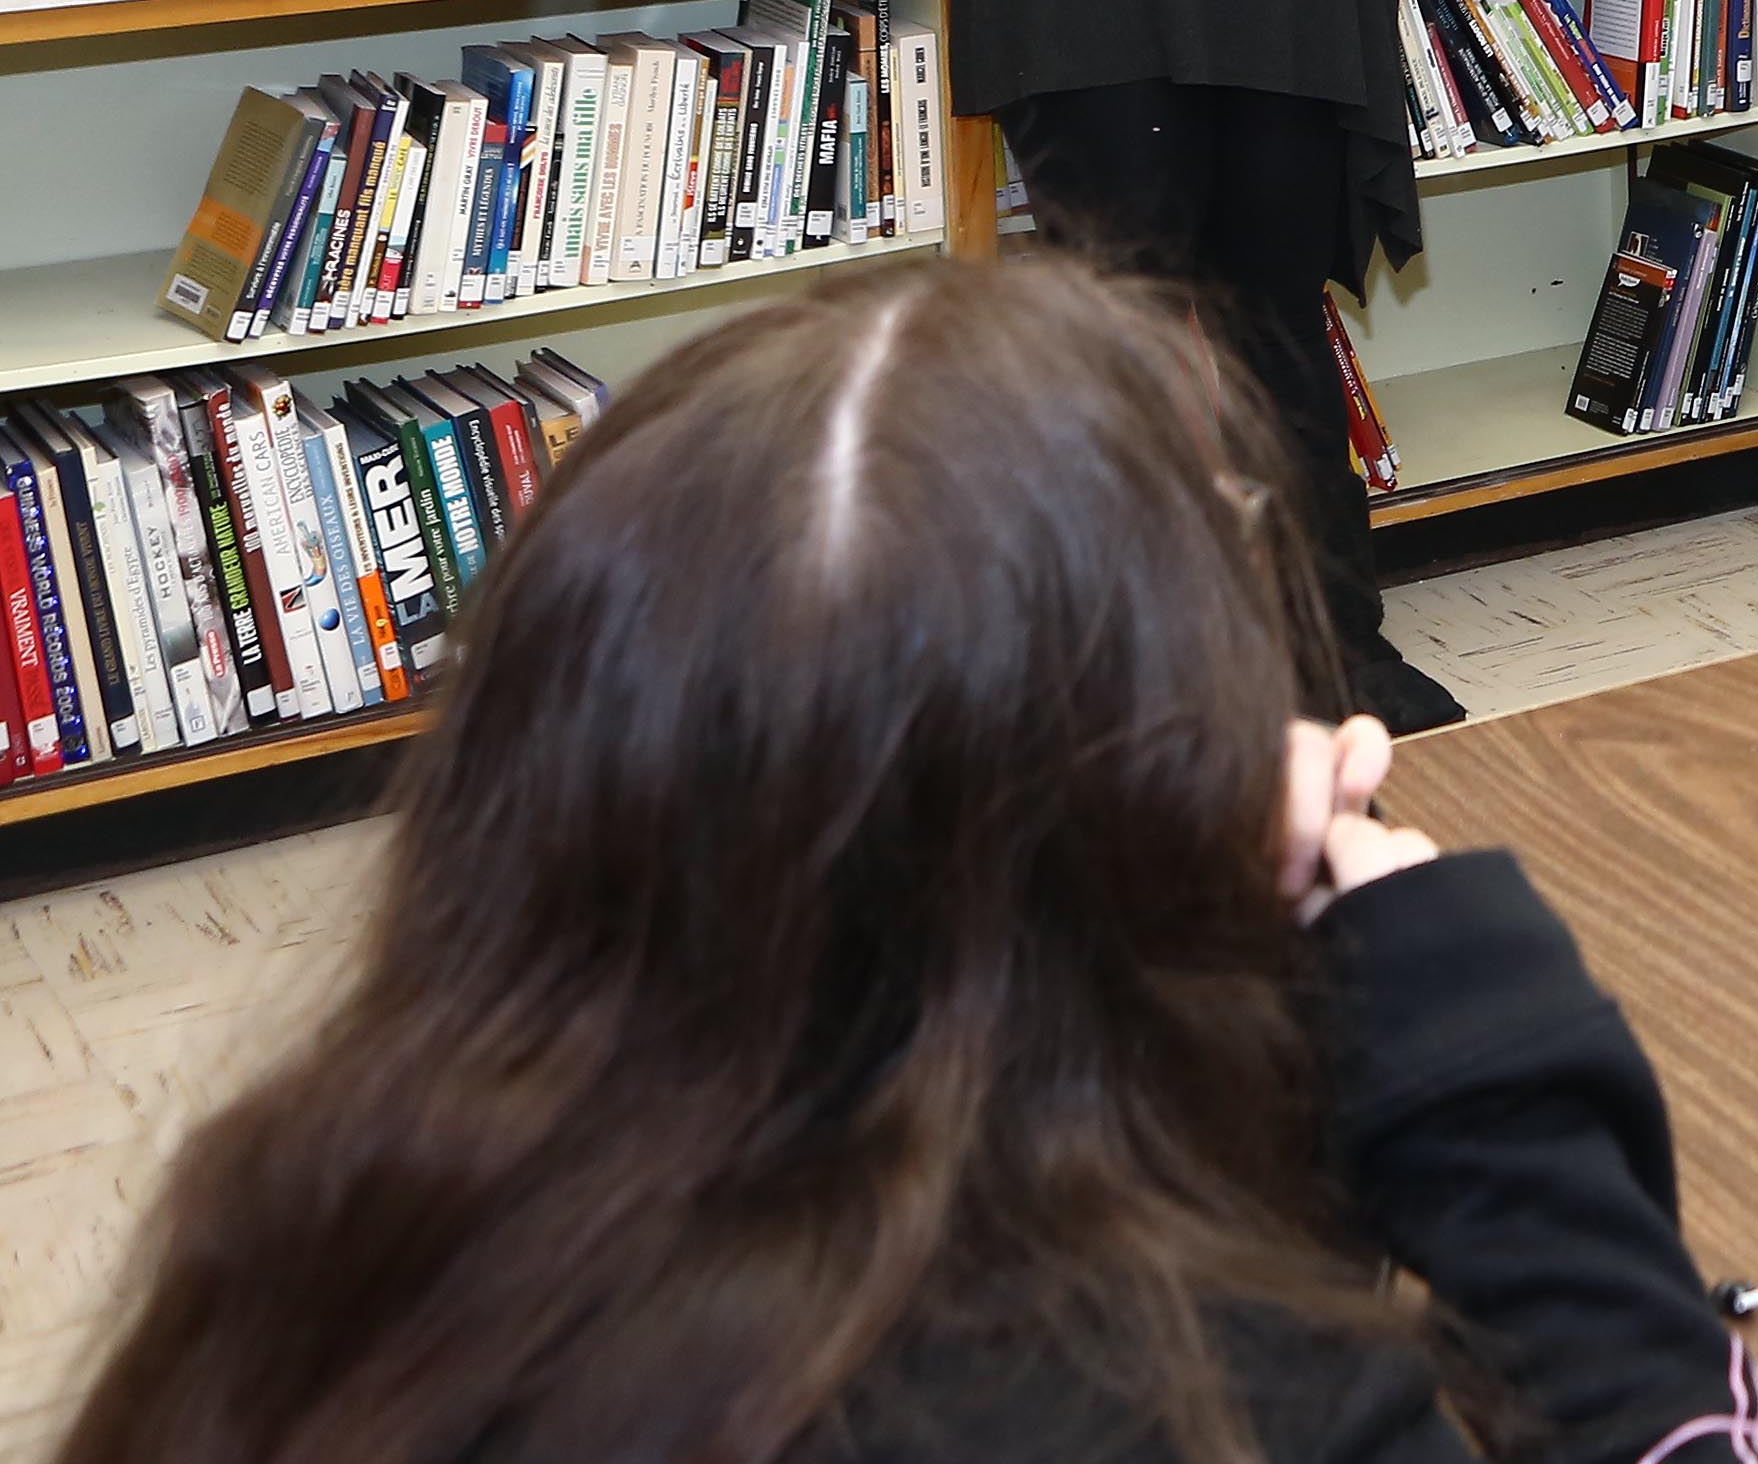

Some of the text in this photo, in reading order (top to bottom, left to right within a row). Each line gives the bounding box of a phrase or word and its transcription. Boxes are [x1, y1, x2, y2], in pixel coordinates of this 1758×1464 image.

[679, 83, 690, 115] Liberté
[880, 78, 890, 93] LES
[459, 106, 482, 216] MARTIN GRAY VIVRE DEBOUT
[601, 171, 617, 189] LES
[668, 129, 685, 181] Écrivains
[819, 120, 838, 164] MAFIA
[326, 208, 352, 265] RACINES
[470, 168, 495, 257] MYTHES ET LÉGENDES
[595, 221, 612, 252] VIVRE
[598, 190, 616, 219] AVEC
[217, 402, 261, 552] 100 merveilles du monde
[249, 430, 291, 555] AMERICAN CARS
[276, 426, 304, 504] ENCYCLOPÉDIE
[431, 435, 480, 555] NOTRE MONDE
[148, 524, 172, 600] HOCKEY
[364, 453, 436, 603] MER
[16, 475, 77, 724] GUINNESS WORLD RECORDS 2004
[123, 546, 157, 672] Les pyramides d'Egypte
[209, 501, 262, 664] LA TERRE GRANDEUR NATURE
[322, 494, 367, 647] LA VIE DES OISEAUX
[10, 588, 38, 669] VRAIMENT
